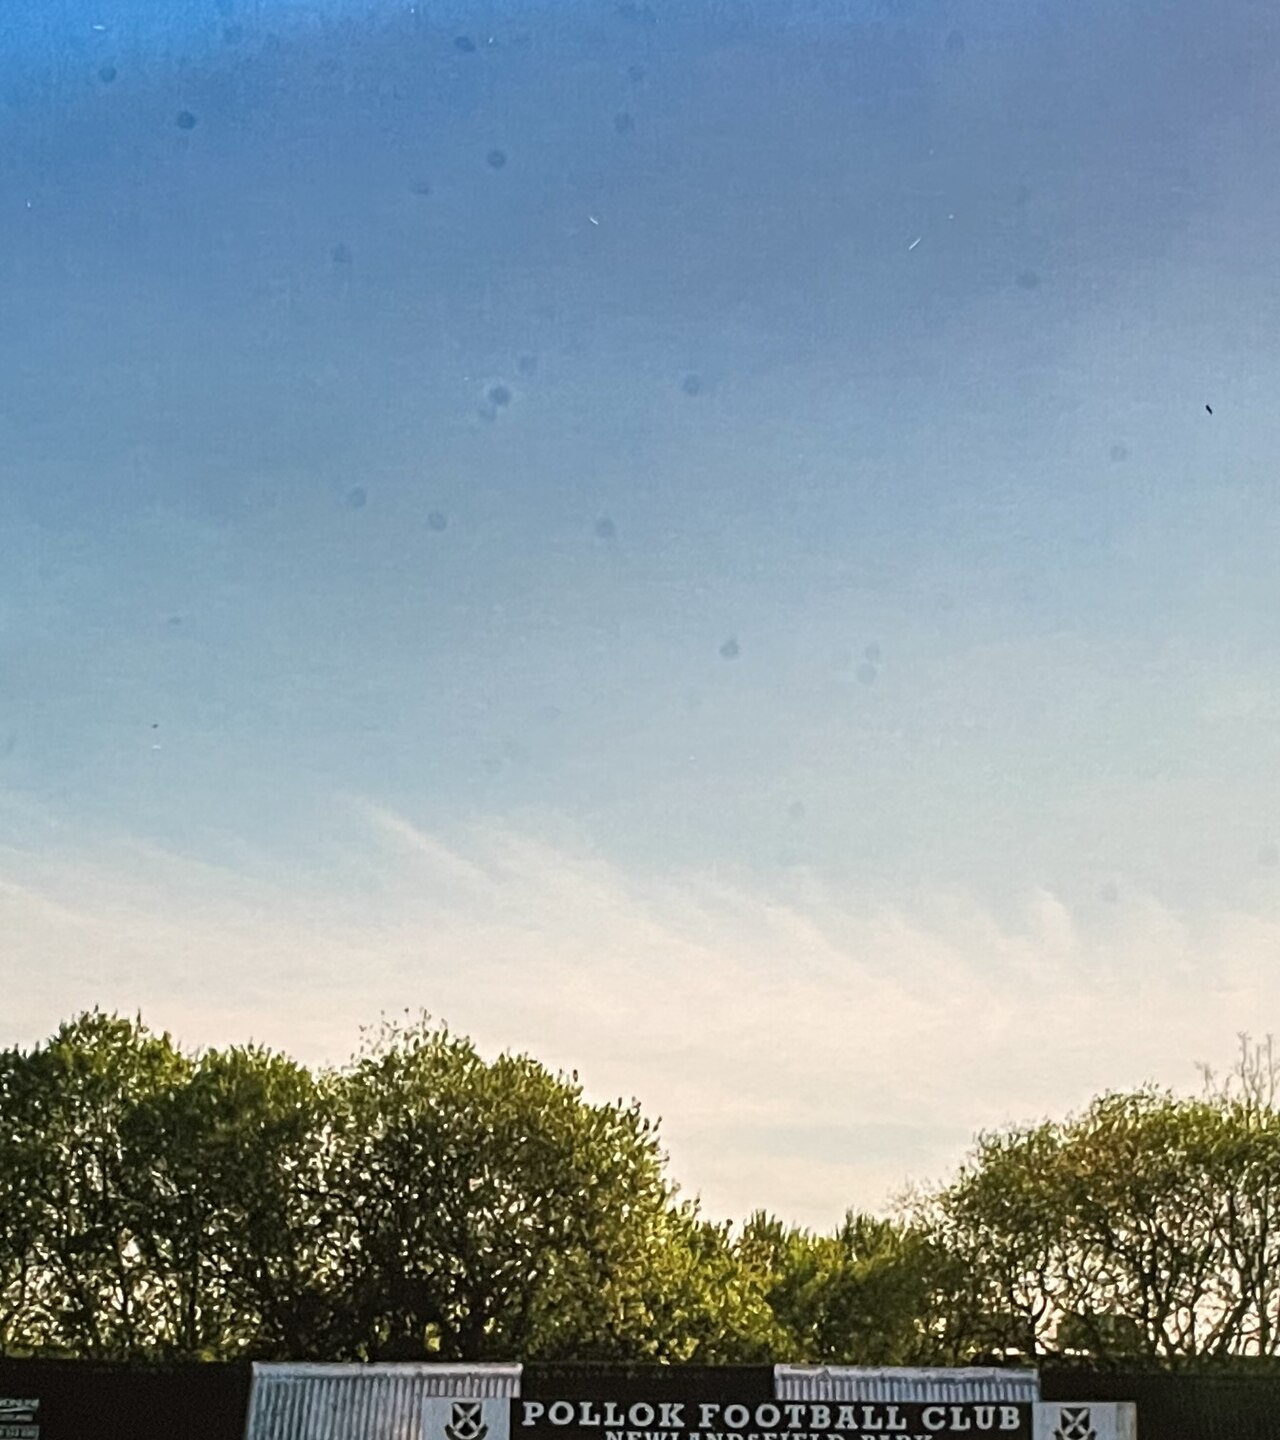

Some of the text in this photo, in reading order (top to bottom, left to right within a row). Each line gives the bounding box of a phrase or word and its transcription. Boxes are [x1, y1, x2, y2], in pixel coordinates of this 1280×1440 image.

[521, 1402, 1020, 1431] POLLOK FOOTBALL CLUB
